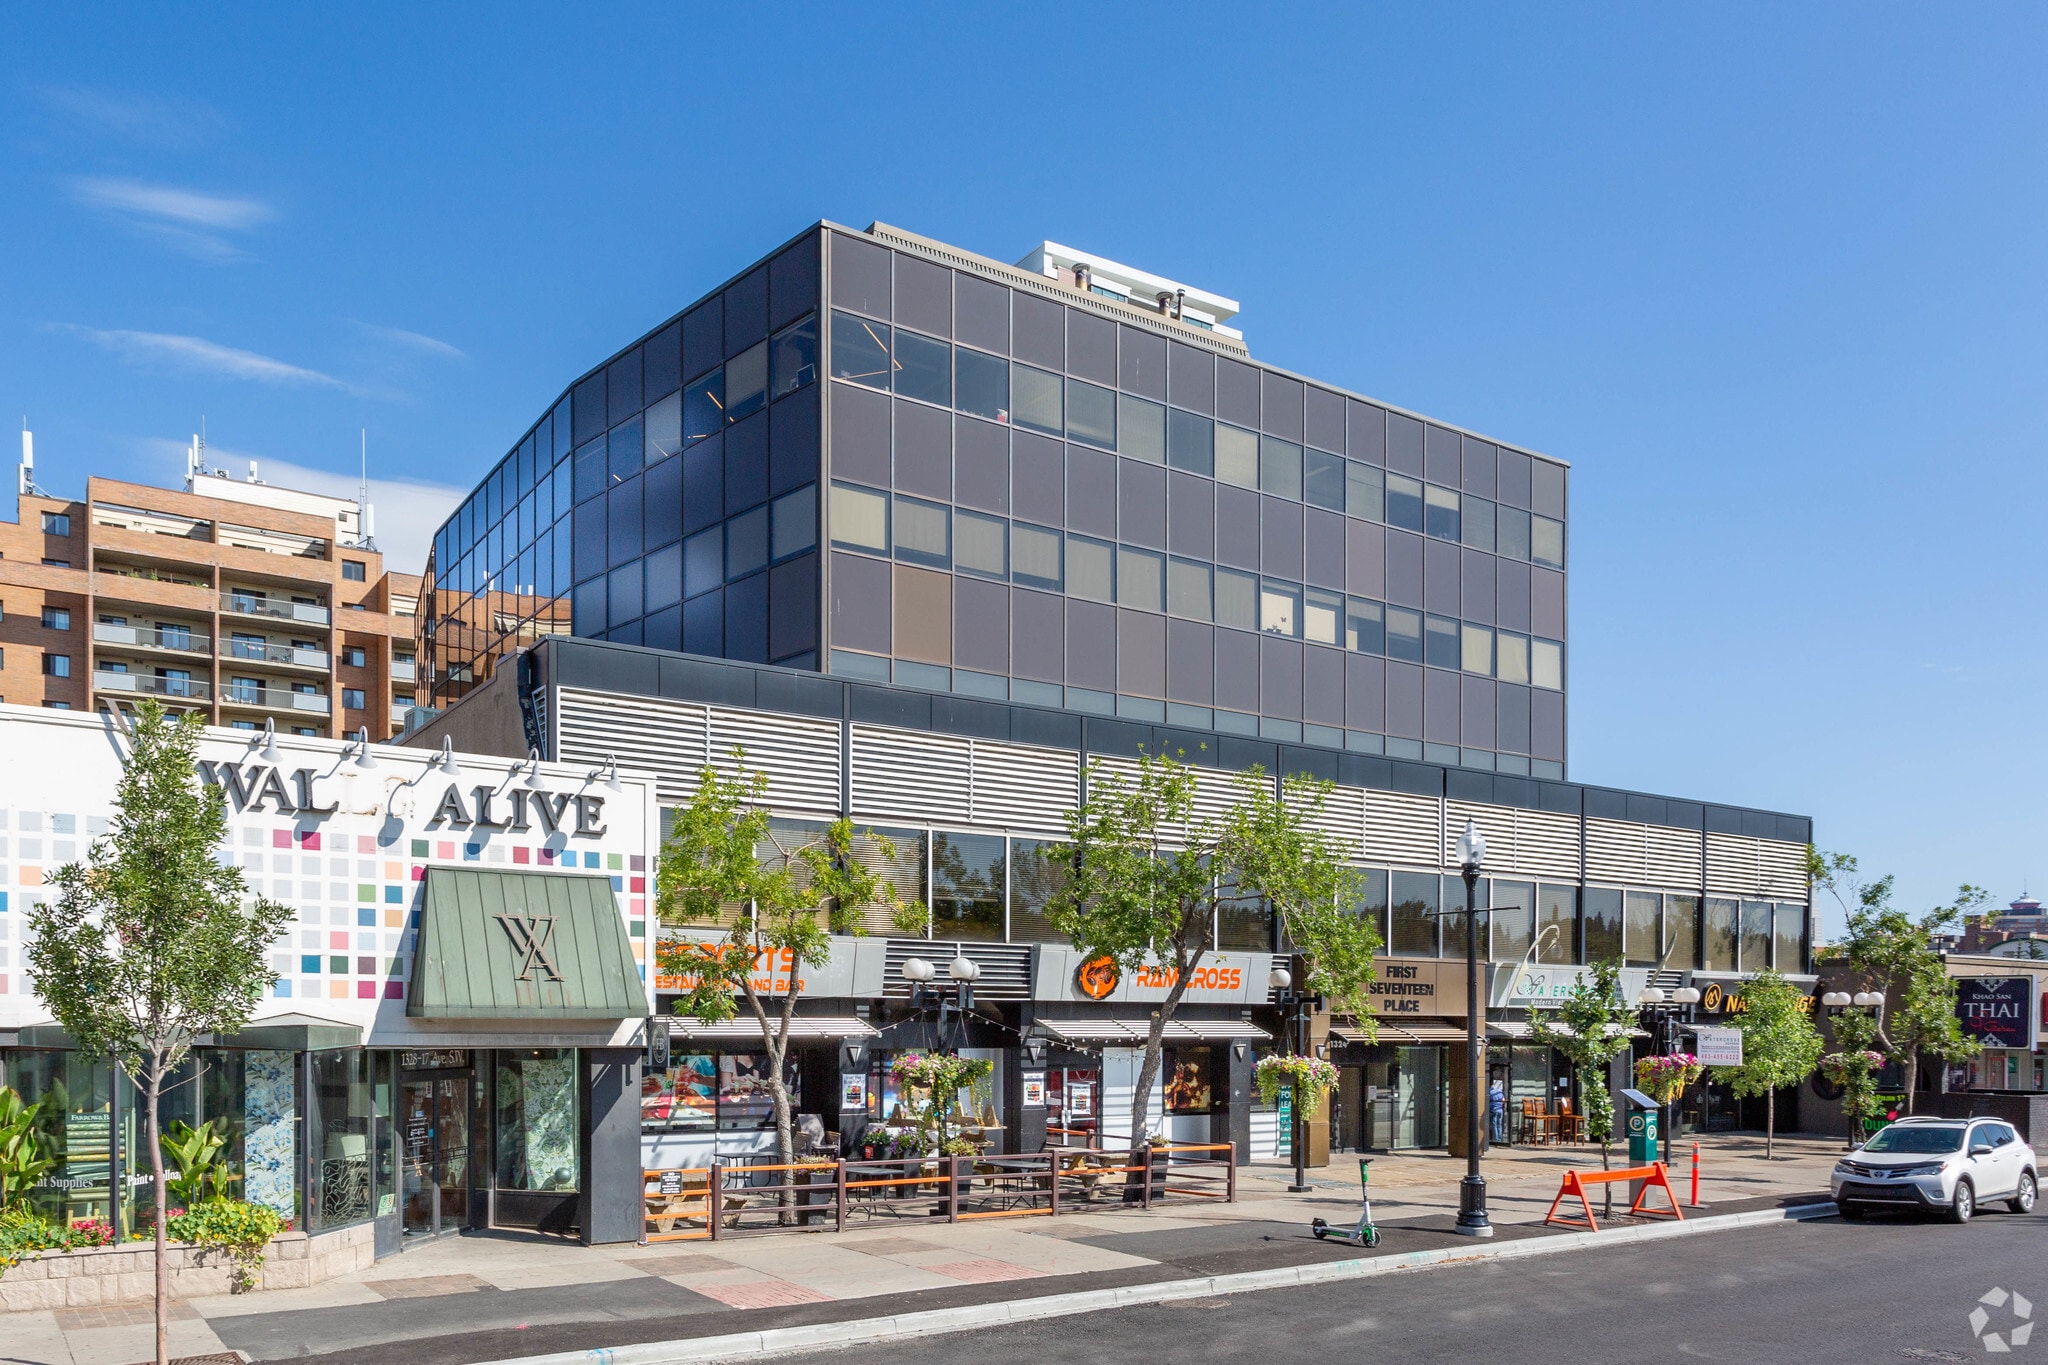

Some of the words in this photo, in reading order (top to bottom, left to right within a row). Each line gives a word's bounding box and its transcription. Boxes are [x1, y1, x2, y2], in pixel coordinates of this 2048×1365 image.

[432, 782, 608, 836] ALIVE
[1386, 965, 1418, 979] FIRST
[1369, 982, 1434, 996] SEVENTEEN
[1383, 999, 1420, 1012] PLACE
[1963, 1002, 2020, 1018] THAI
[1330, 1040, 1348, 1049] 1324
[1281, 1091, 1292, 1099] FO
[50, 1175, 95, 1191] Supplies
[127, 1174, 148, 1186] Paint
